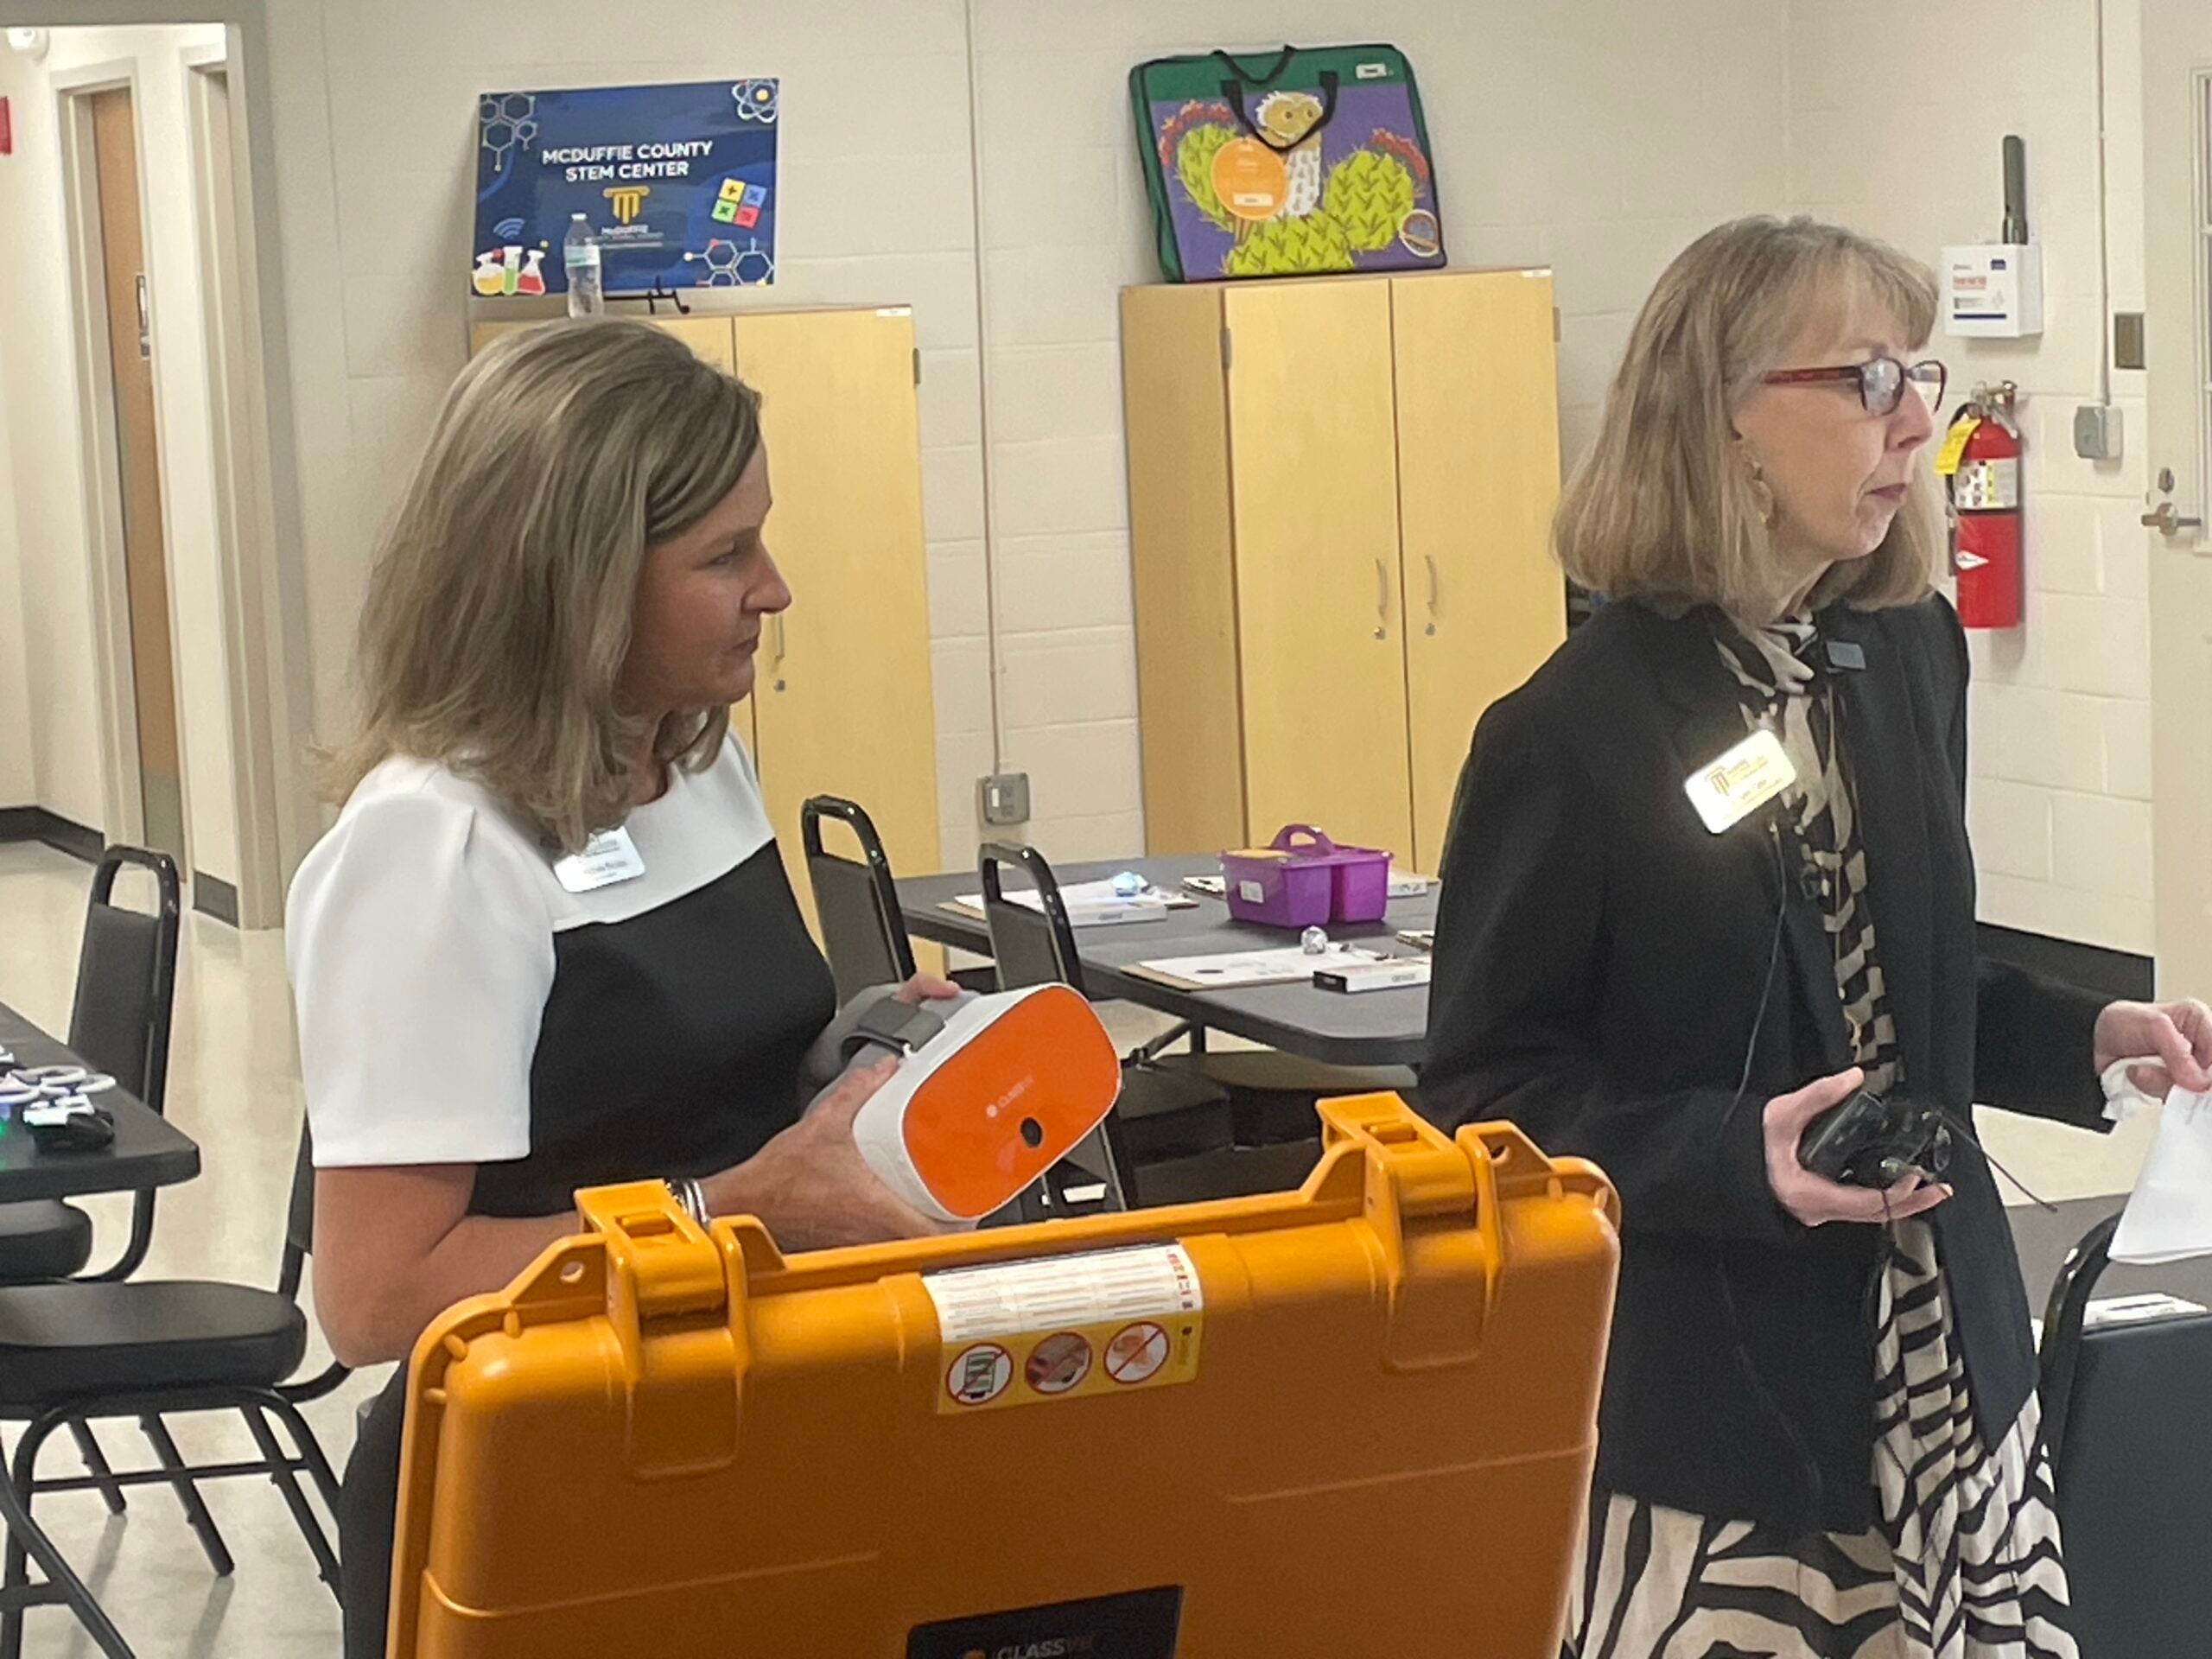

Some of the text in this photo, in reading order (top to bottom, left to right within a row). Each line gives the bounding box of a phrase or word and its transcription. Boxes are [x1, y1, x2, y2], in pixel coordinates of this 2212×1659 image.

[543, 140, 713, 164] MCDUFFIE COUNTY
[565, 162, 690, 181] STEM CENTER
